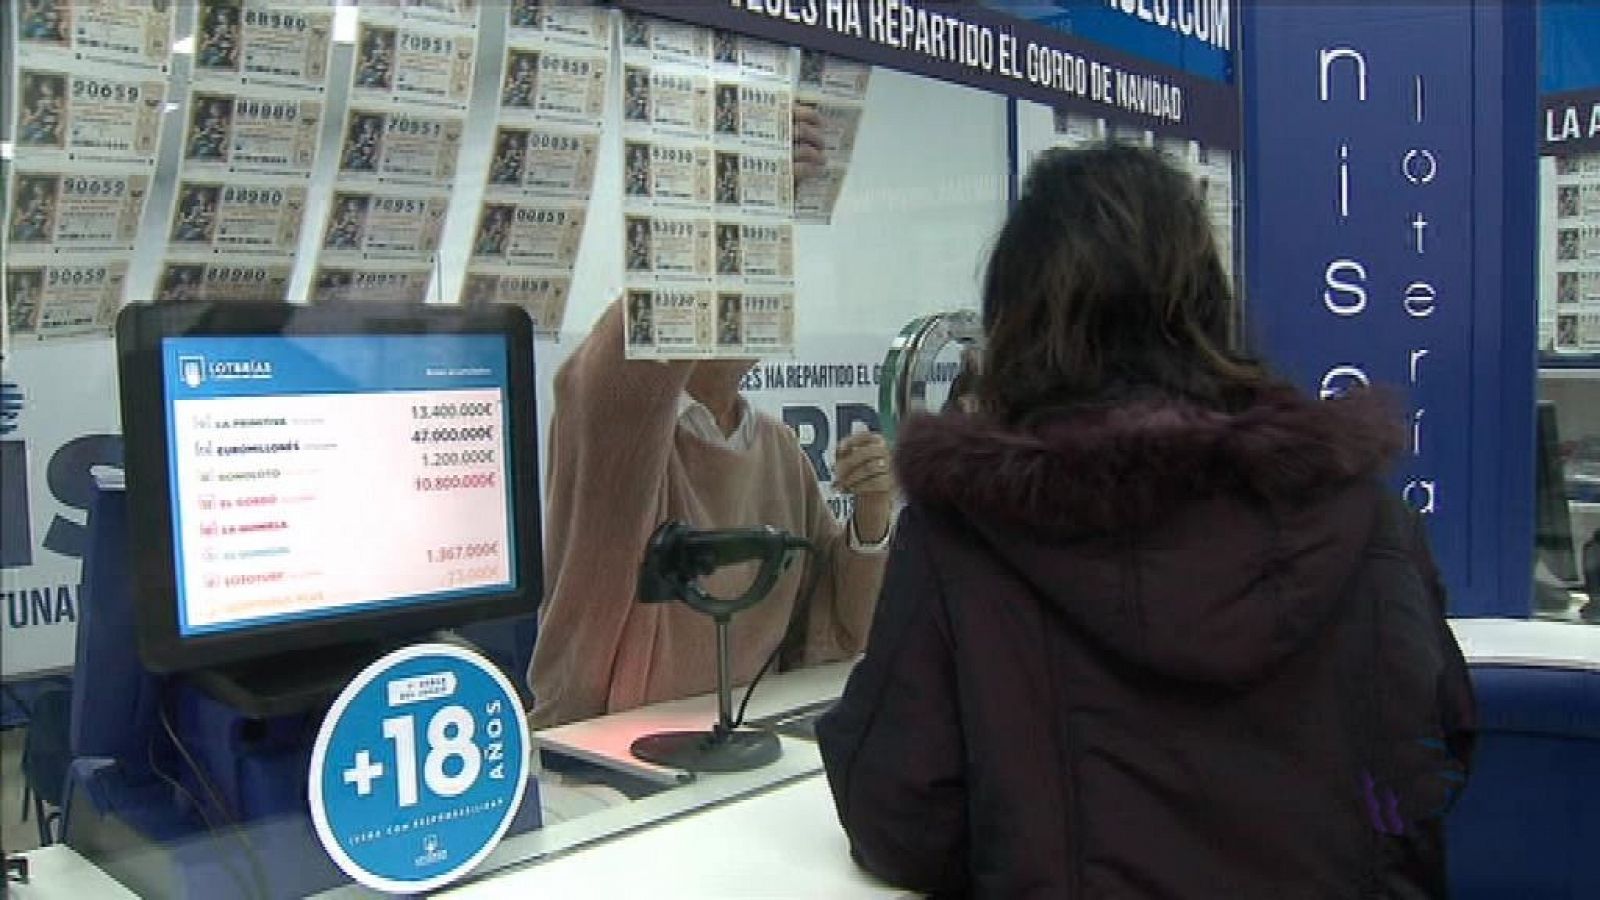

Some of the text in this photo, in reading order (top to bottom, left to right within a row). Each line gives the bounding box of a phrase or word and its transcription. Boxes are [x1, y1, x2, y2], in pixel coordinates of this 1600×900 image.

[826, 0, 863, 38] HA
[869, 0, 994, 70] REPARTIDO
[1000, 32, 1022, 79] EL
[1027, 41, 1087, 95] GORDO
[1091, 62, 1113, 104] DE
[1116, 69, 1181, 121] NAVIDAD
[1547, 106, 1580, 141] LA
[766, 364, 784, 388] HA
[786, 364, 853, 388] REPARTIDO
[857, 365, 870, 386] EL
[343, 705, 482, 808] +18
[485, 700, 506, 779] AÑOS
